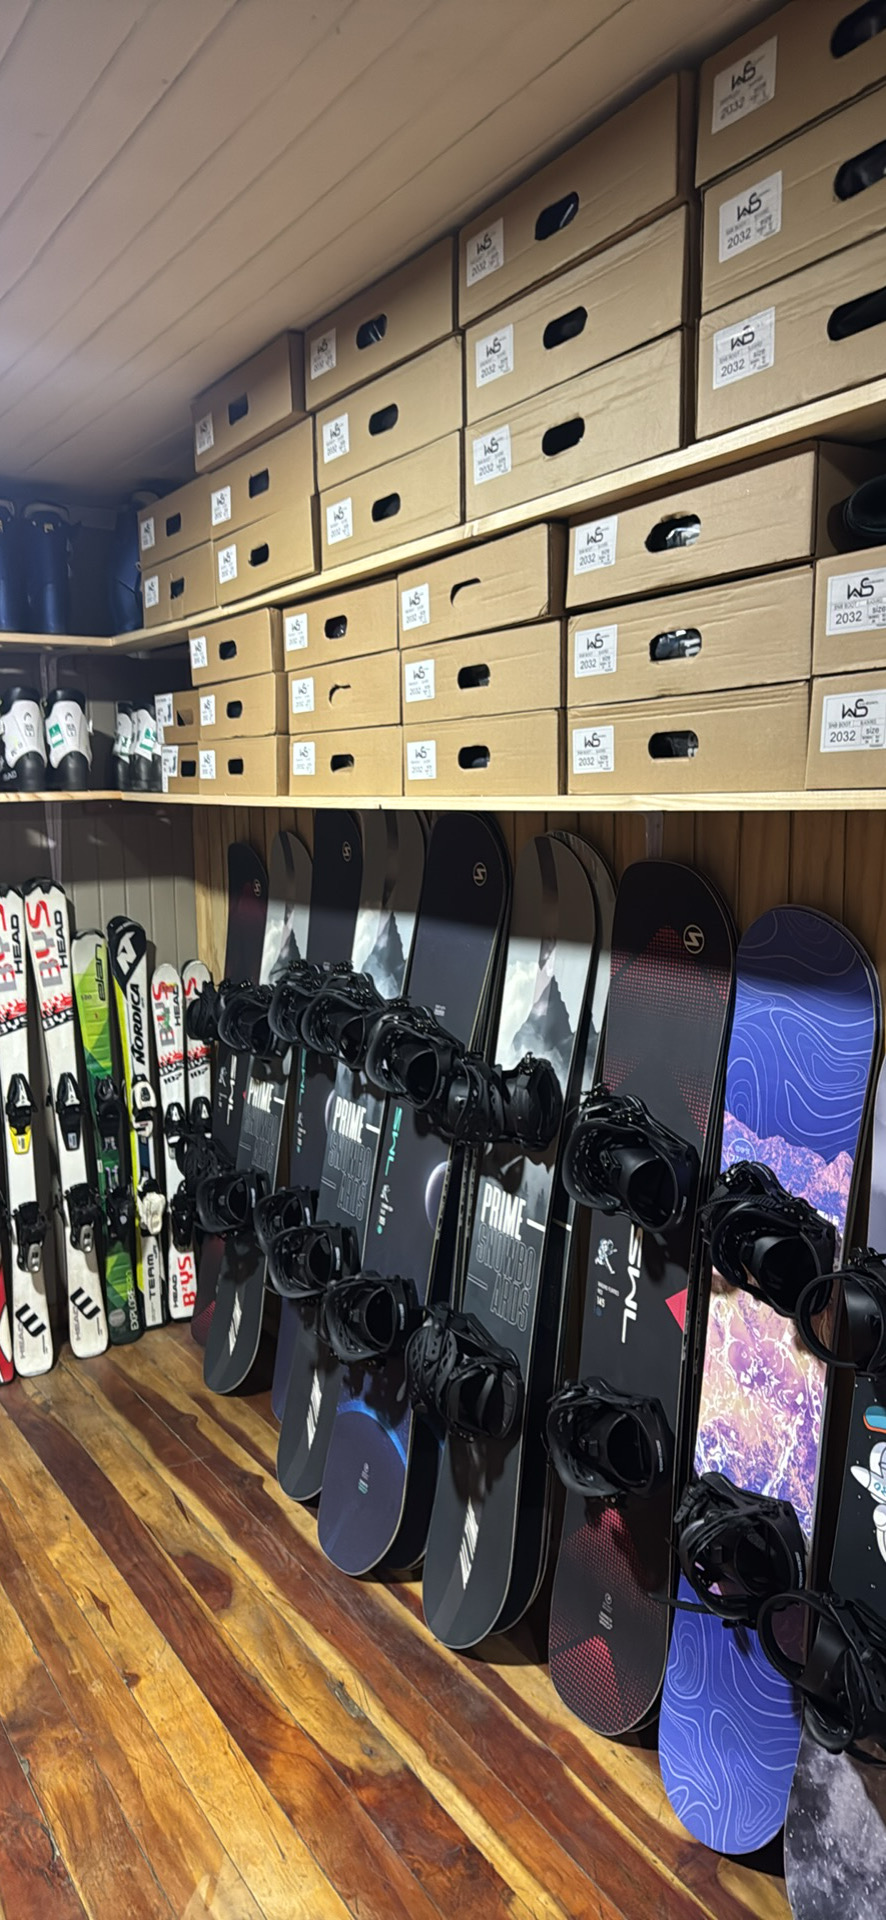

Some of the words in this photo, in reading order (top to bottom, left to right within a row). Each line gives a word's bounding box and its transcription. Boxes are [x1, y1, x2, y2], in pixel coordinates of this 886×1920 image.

[727, 227, 751, 250] 2032
[720, 358, 745, 377] 2032
[835, 610, 863, 625] 2032
[830, 730, 856, 743] 2032
[11, 914, 23, 974] HEAD
[54, 910, 68, 969] HEAD
[130, 983, 146, 1066] NORDICA
[247, 1076, 274, 1113] PRIME
[332, 1096, 367, 1144] PRIME
[480, 1182, 527, 1241] PRIME
[147, 1254, 156, 1300] TEAM
[490, 1273, 531, 1333] ARDS
